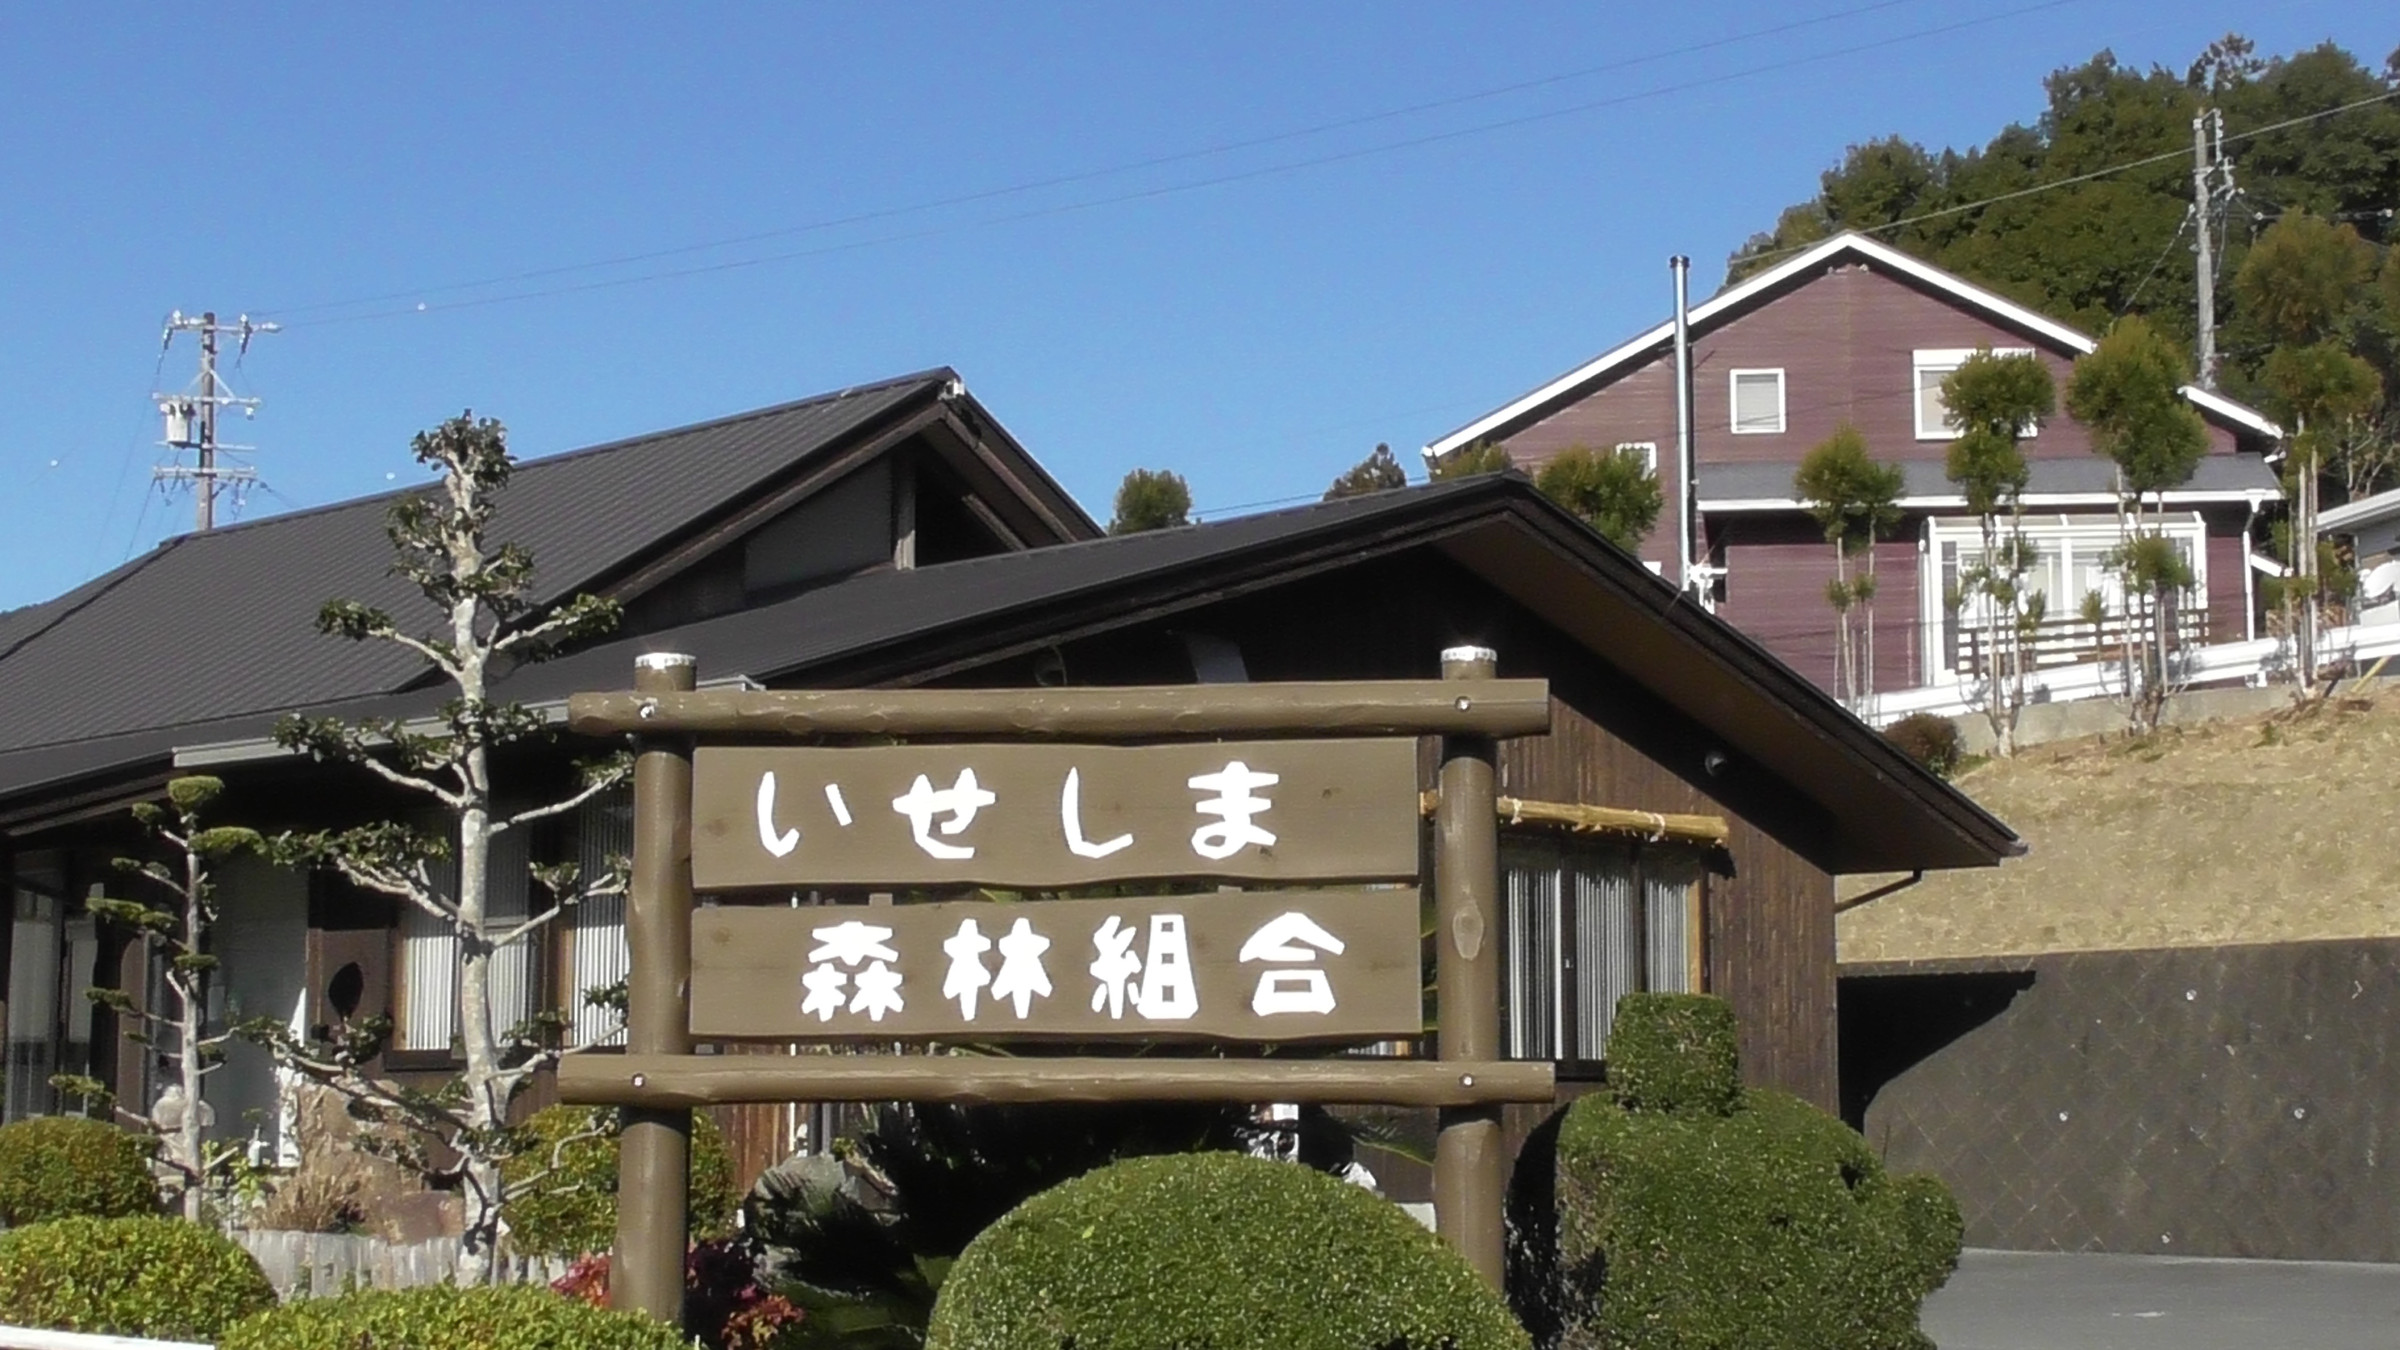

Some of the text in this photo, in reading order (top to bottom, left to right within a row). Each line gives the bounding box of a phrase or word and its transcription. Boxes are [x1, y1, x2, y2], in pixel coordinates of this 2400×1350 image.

[756, 760, 1280, 861] いせしま
[801, 911, 1346, 1023] 森林組合
